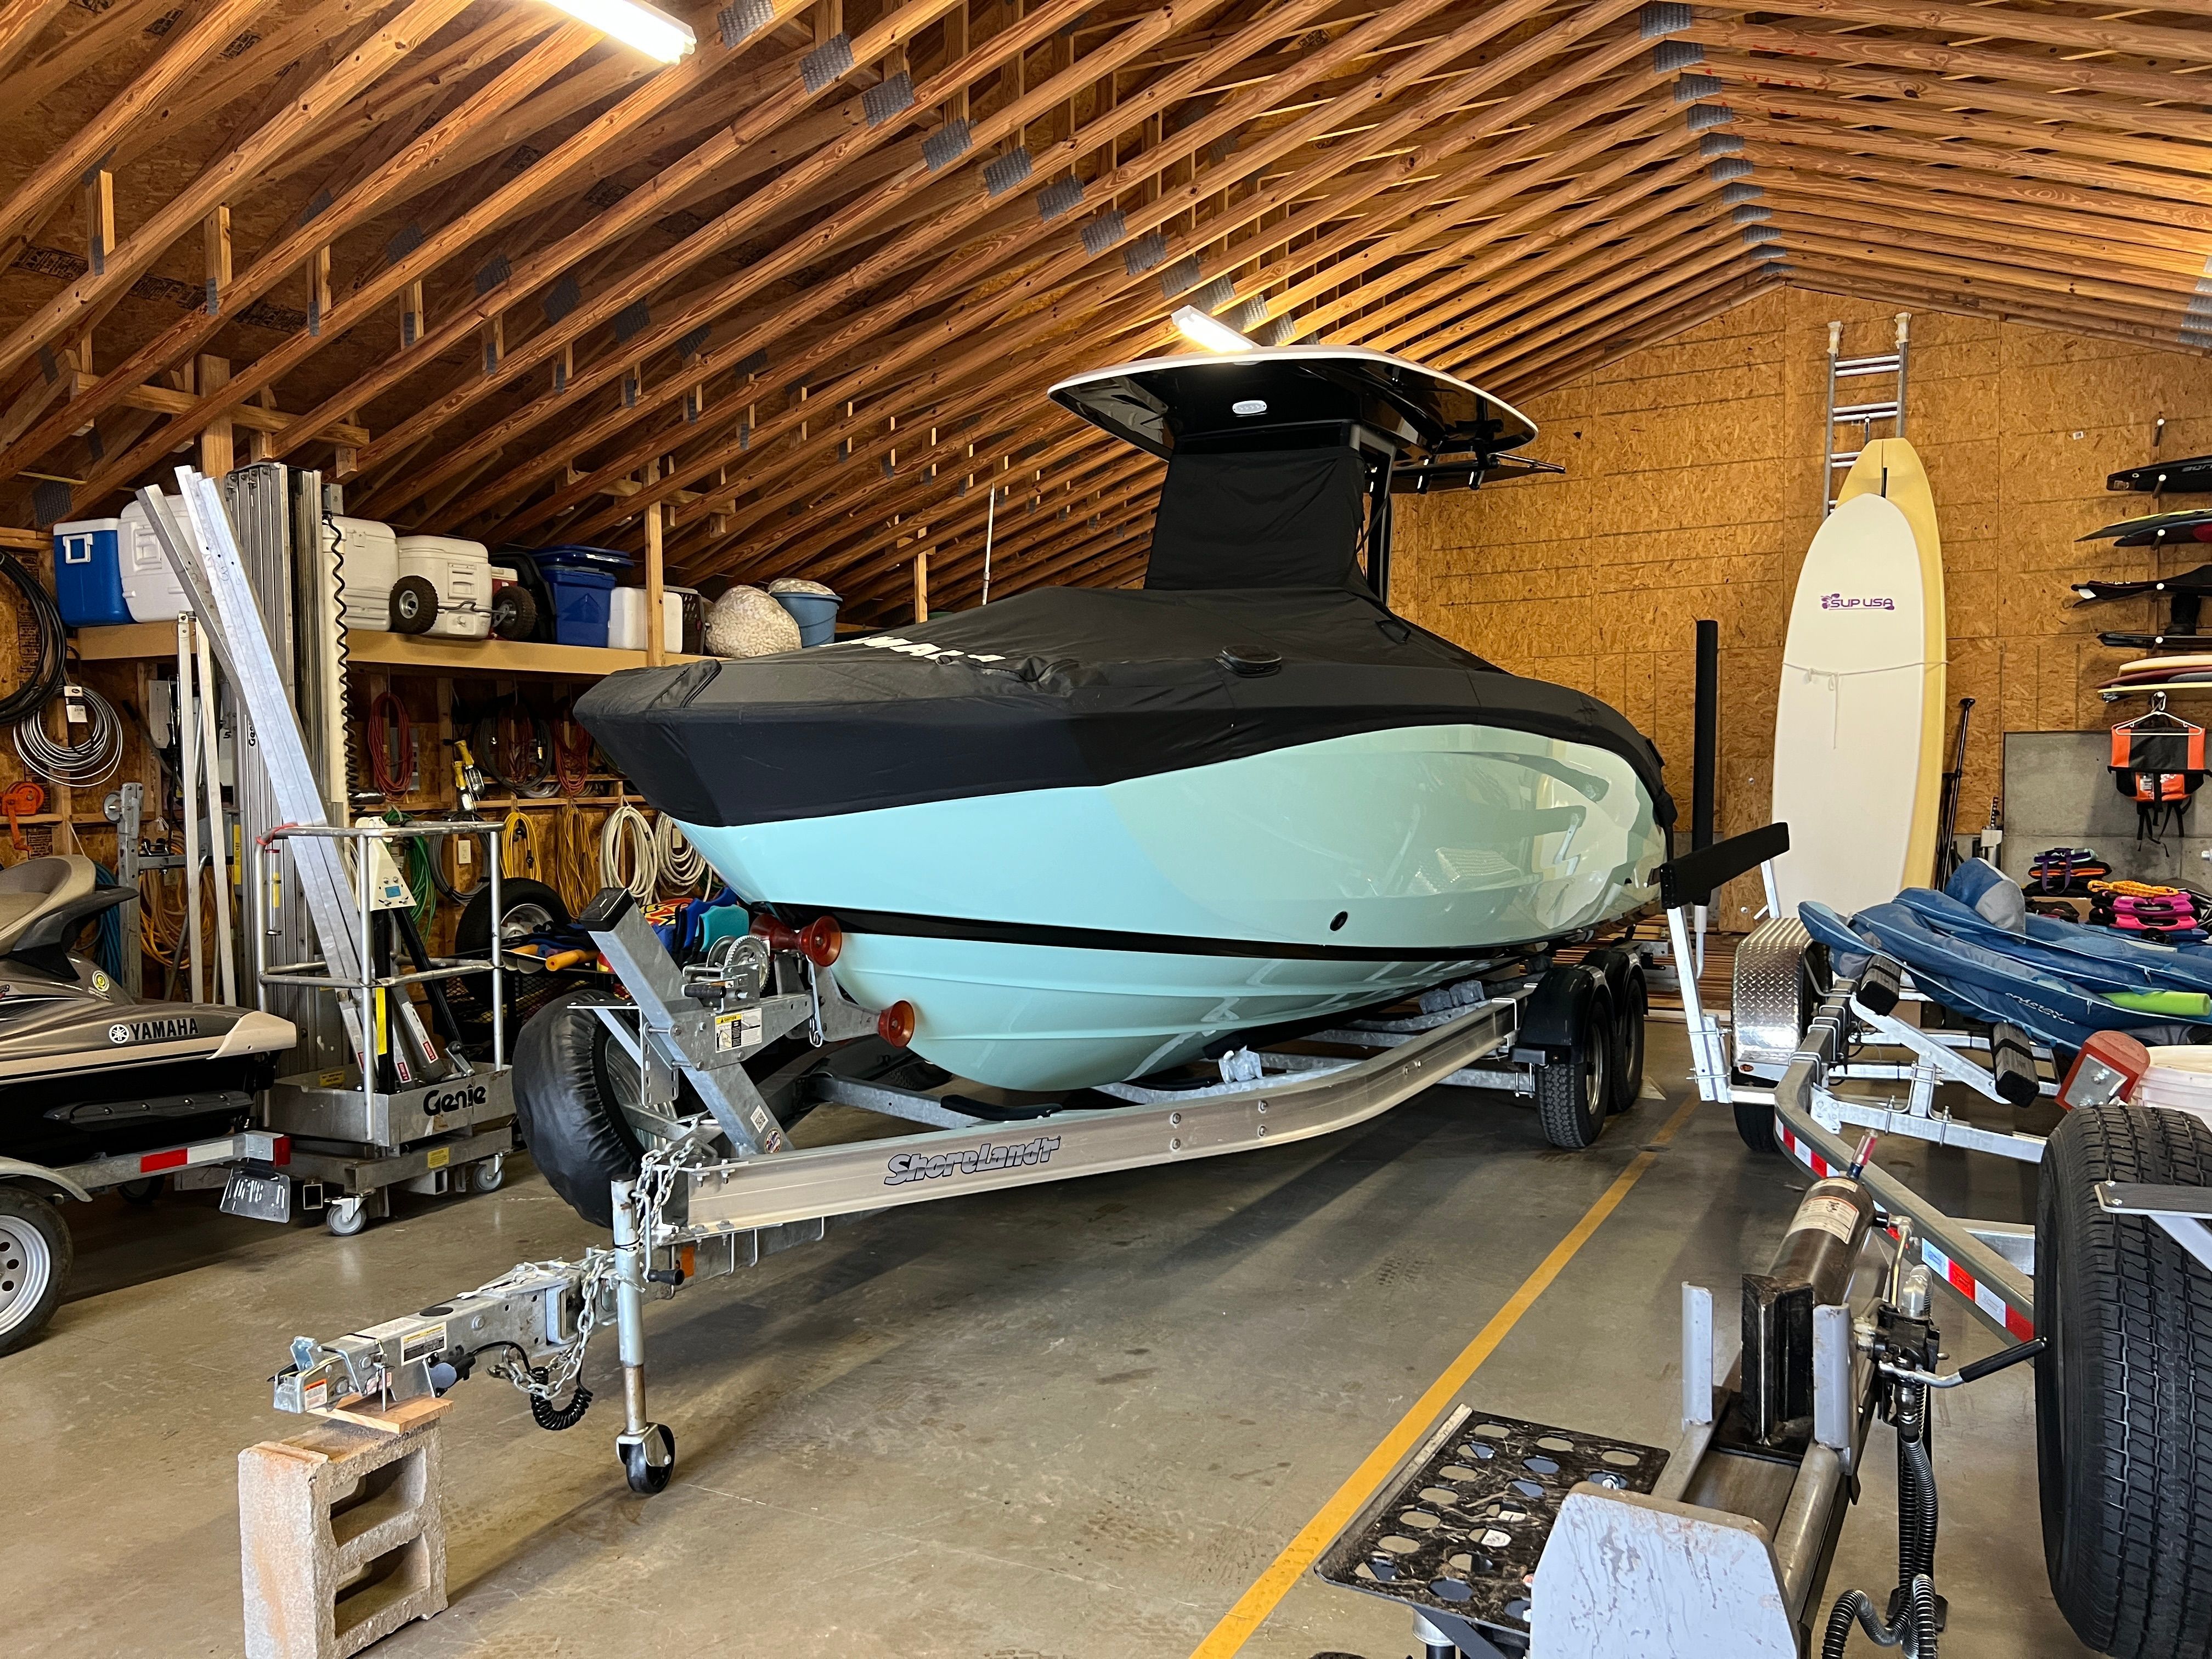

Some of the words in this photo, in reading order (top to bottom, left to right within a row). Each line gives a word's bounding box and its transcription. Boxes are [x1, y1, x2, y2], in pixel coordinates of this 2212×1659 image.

[1830, 599, 1860, 608] SUP
[1863, 599, 1893, 607] USA
[129, 1018, 199, 1040] YAMAHA
[423, 1084, 486, 1116] Genie
